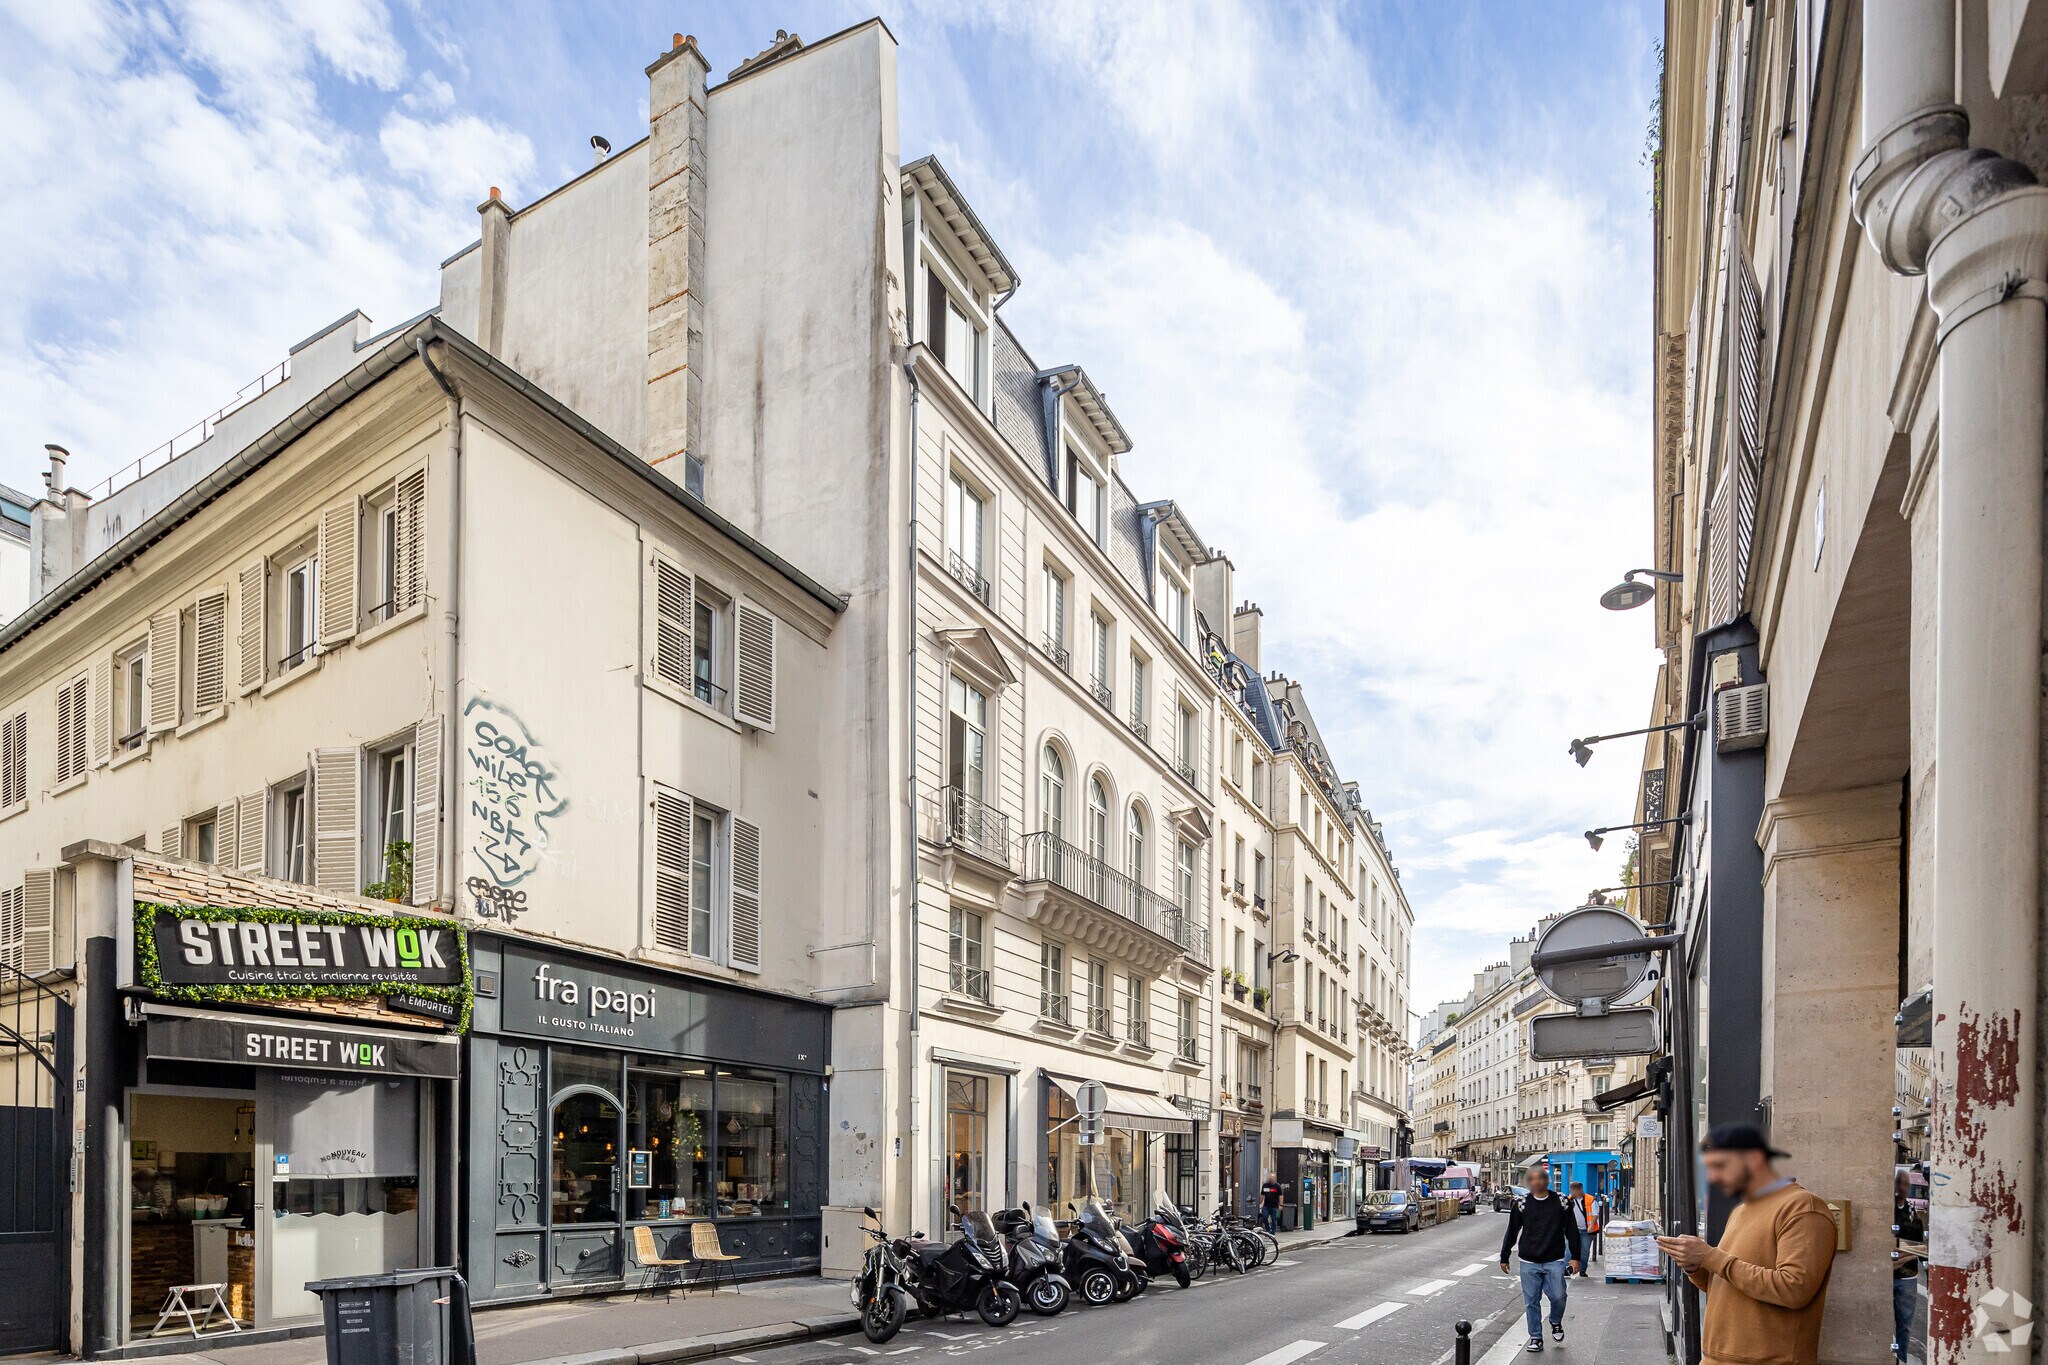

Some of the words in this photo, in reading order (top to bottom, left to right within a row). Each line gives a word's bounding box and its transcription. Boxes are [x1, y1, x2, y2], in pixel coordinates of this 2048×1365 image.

[180, 919, 346, 967] STREET
[360, 926, 446, 969] WOK
[228, 970, 274, 980] Cuisine
[276, 970, 302, 980] thaï
[304, 971, 318, 980] et
[320, 971, 369, 981] indienne
[371, 971, 419, 981] revisitée
[535, 964, 579, 1004] fra
[591, 985, 656, 1023] papi
[408, 996, 454, 1015] EMPORTER
[538, 1015, 548, 1024] IL
[551, 1018, 586, 1030] GUSTO
[590, 1023, 634, 1037] ITALIANO
[246, 1033, 332, 1062] STREET
[339, 1041, 385, 1067] WOK
[331, 1149, 367, 1159] NOUVEAU
